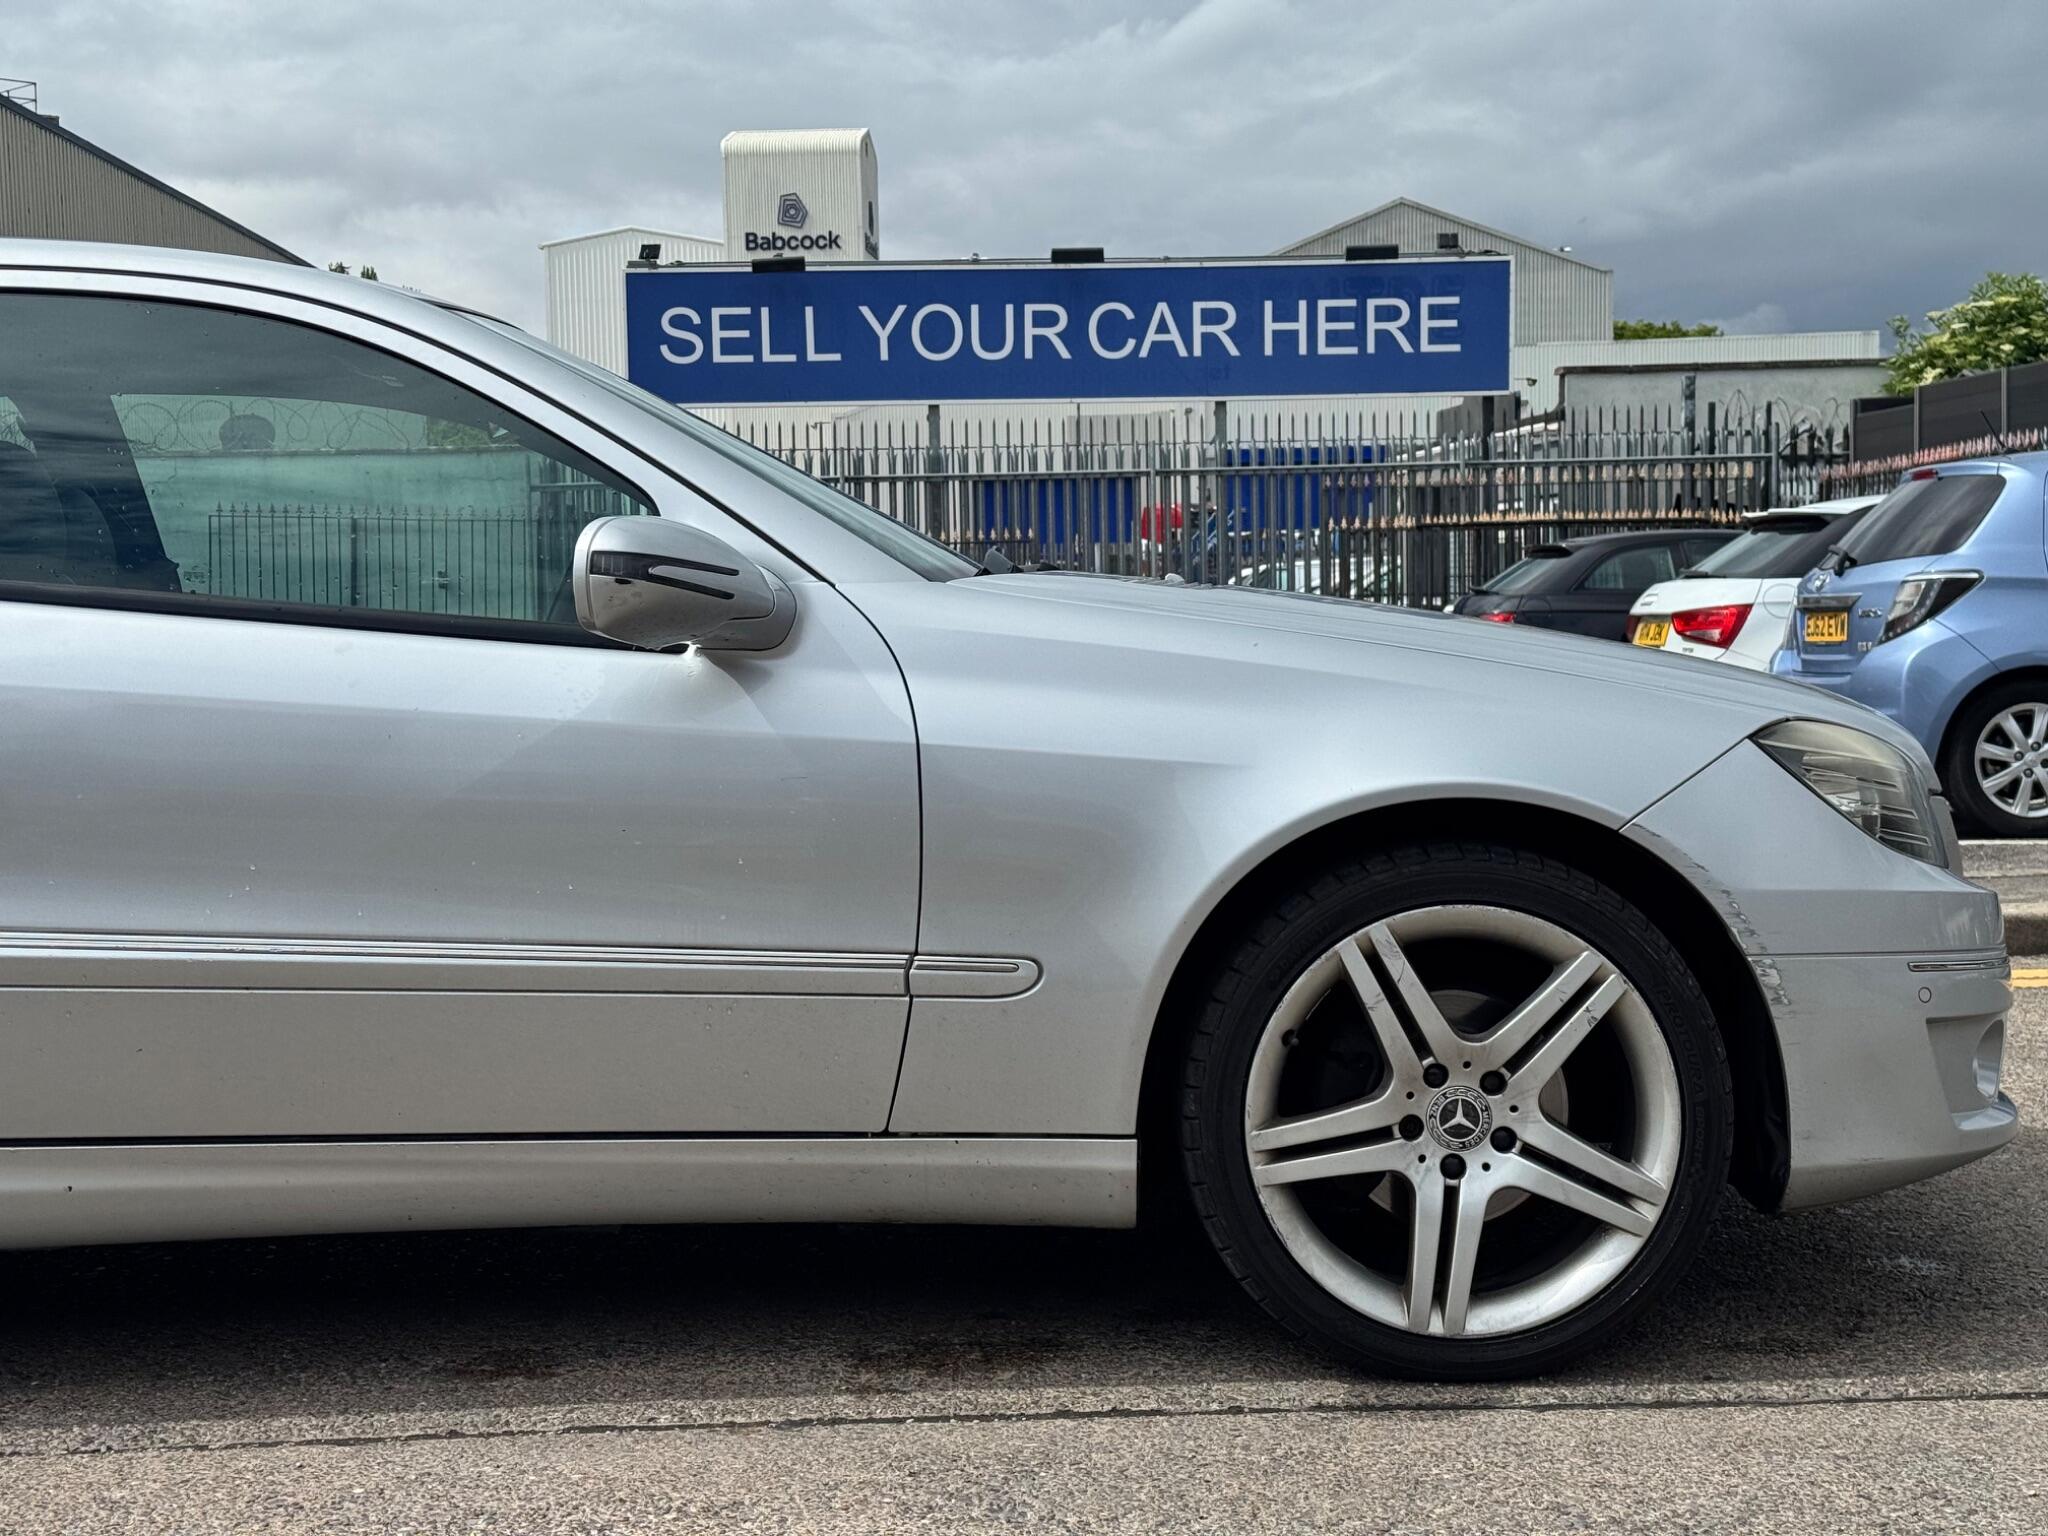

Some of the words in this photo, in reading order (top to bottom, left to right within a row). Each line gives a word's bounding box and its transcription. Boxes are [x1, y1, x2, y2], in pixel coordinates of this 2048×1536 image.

[745, 230, 841, 252] Babcock
[660, 306, 842, 364] SELL
[858, 303, 1072, 361] YOUR
[1088, 301, 1241, 360] CAR
[1264, 296, 1462, 356] HERE
[1430, 1095, 1446, 1117] BENZ
[1464, 1111, 1490, 1148] MERCEDES
